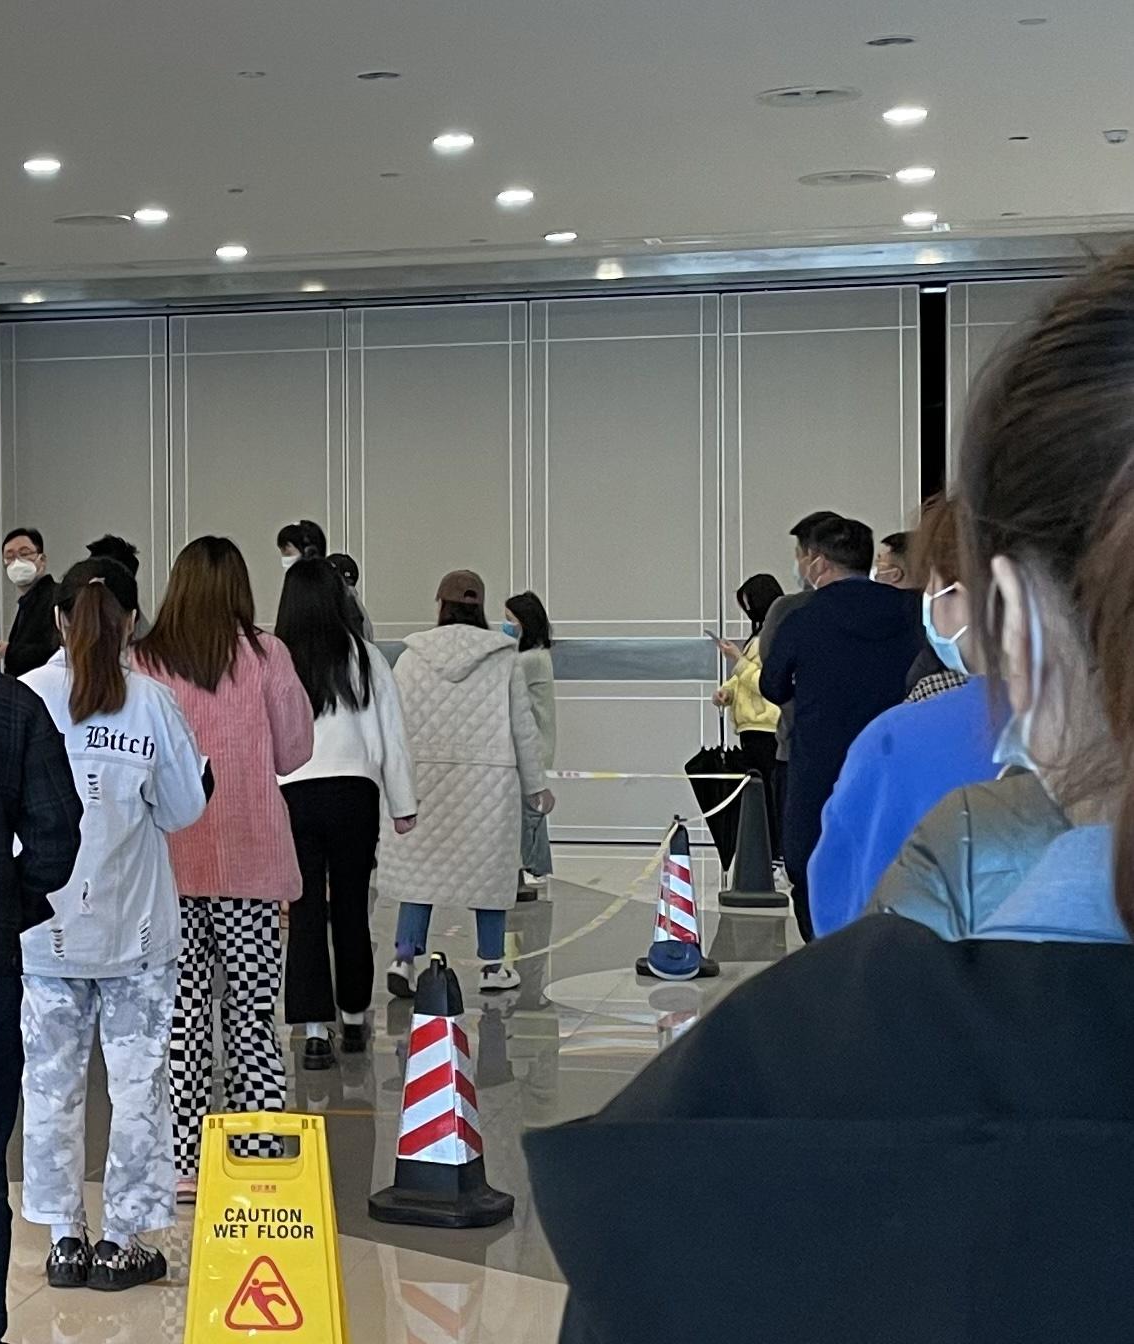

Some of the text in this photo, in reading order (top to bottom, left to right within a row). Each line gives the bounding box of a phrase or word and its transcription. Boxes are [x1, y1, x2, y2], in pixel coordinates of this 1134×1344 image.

[84, 725, 155, 760] Bitch
[224, 1207, 302, 1223] CAUTION
[213, 1223, 314, 1239] WET FLOOR
